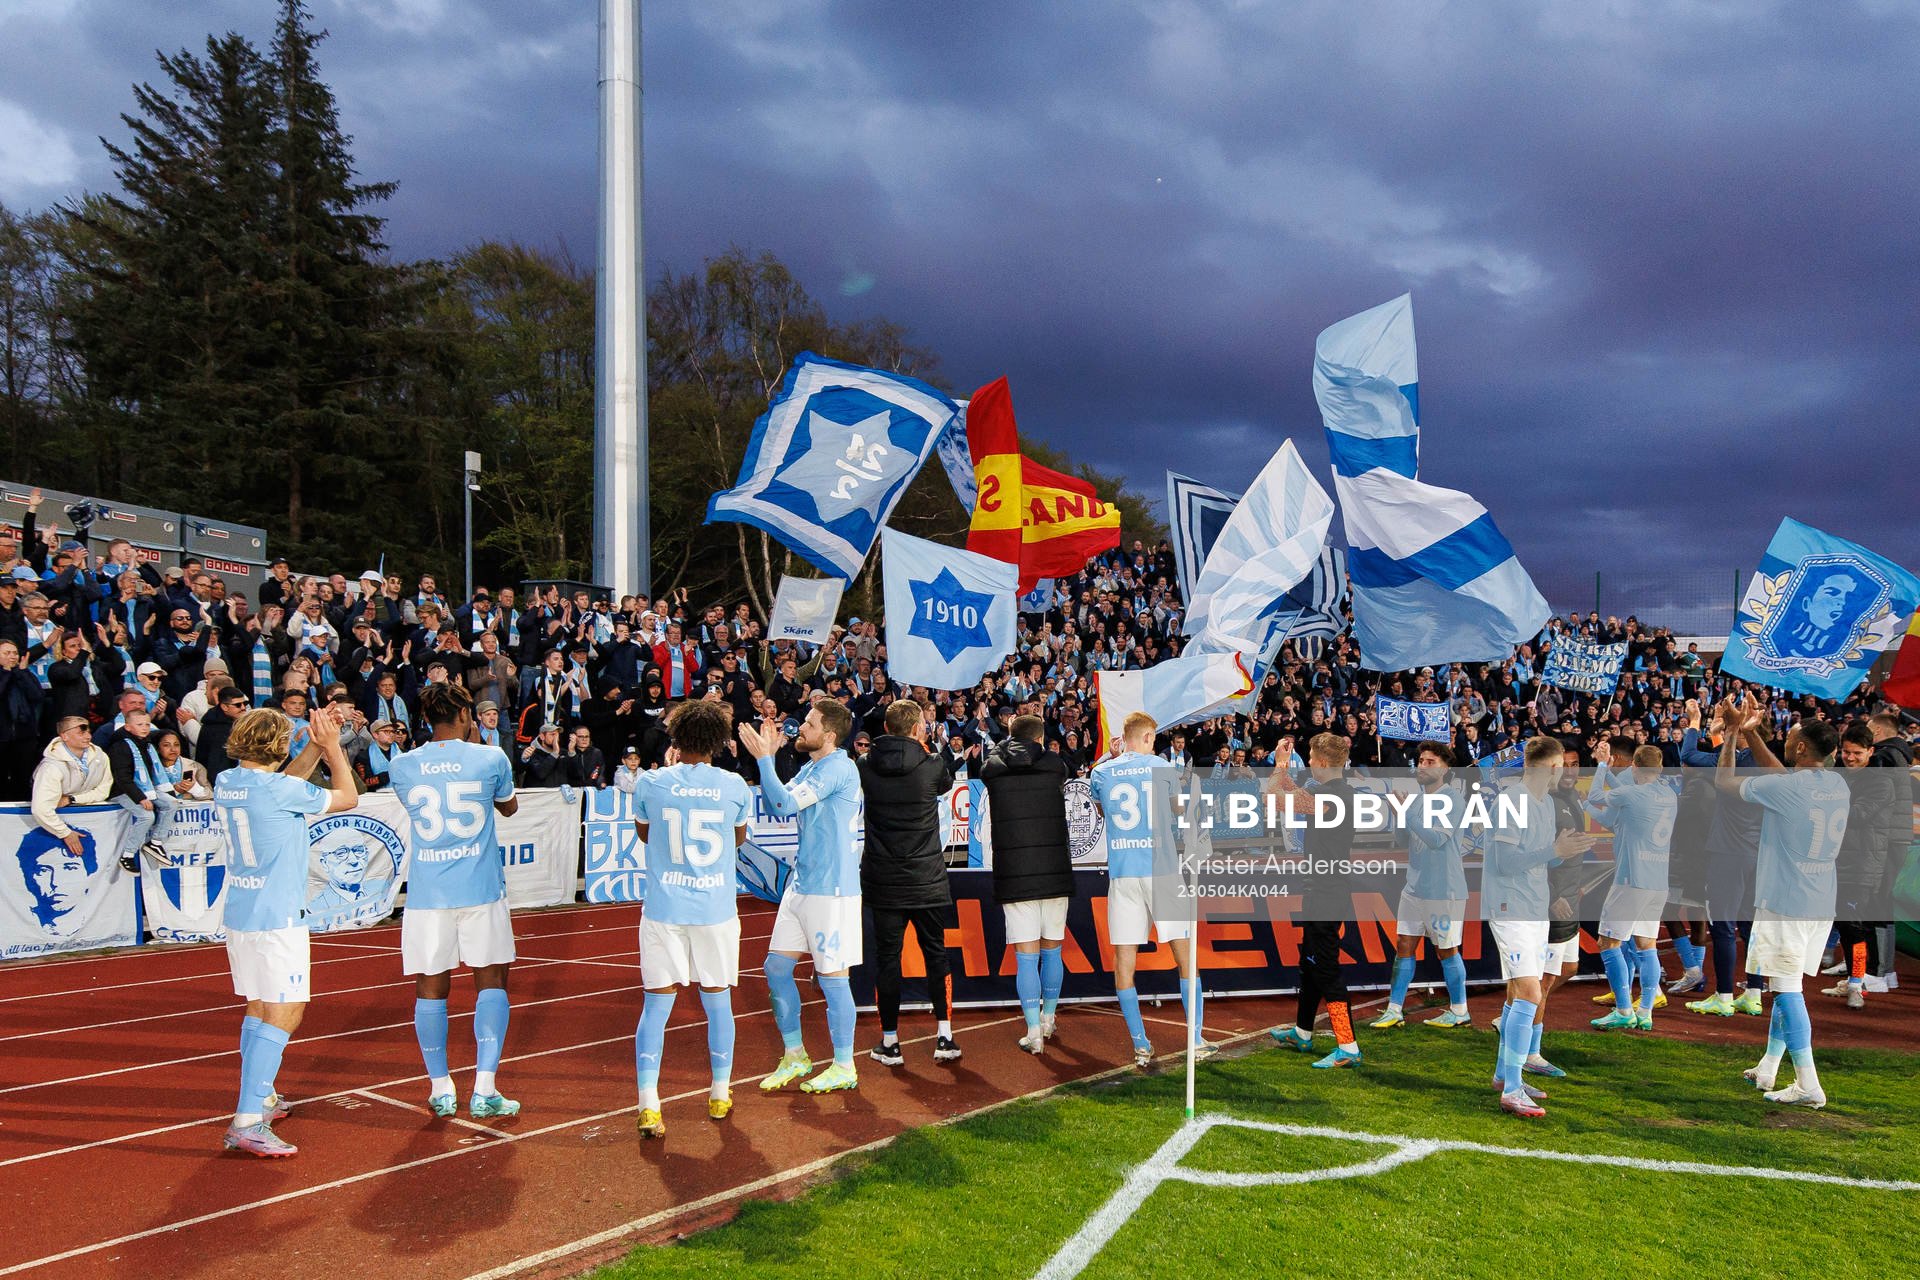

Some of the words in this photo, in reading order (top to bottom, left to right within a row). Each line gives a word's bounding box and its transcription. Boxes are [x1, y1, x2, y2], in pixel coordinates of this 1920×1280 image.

[922, 597, 978, 629] 1910
[784, 626, 814, 635] Skåne
[1558, 671, 1601, 691] 2003
[420, 761, 462, 775] Kotto
[1111, 766, 1153, 777] Larsson
[216, 786, 248, 800] Nanasi
[671, 783, 721, 801] Ceesay
[407, 780, 485, 842] 35
[1109, 780, 1157, 832] 31
[216, 806, 258, 868] 11
[354, 819, 399, 850] KLUBBEN
[661, 807, 725, 867] 15
[170, 852, 216, 867] MFF
[1430, 913, 1451, 932] 20
[815, 930, 841, 953] 24
